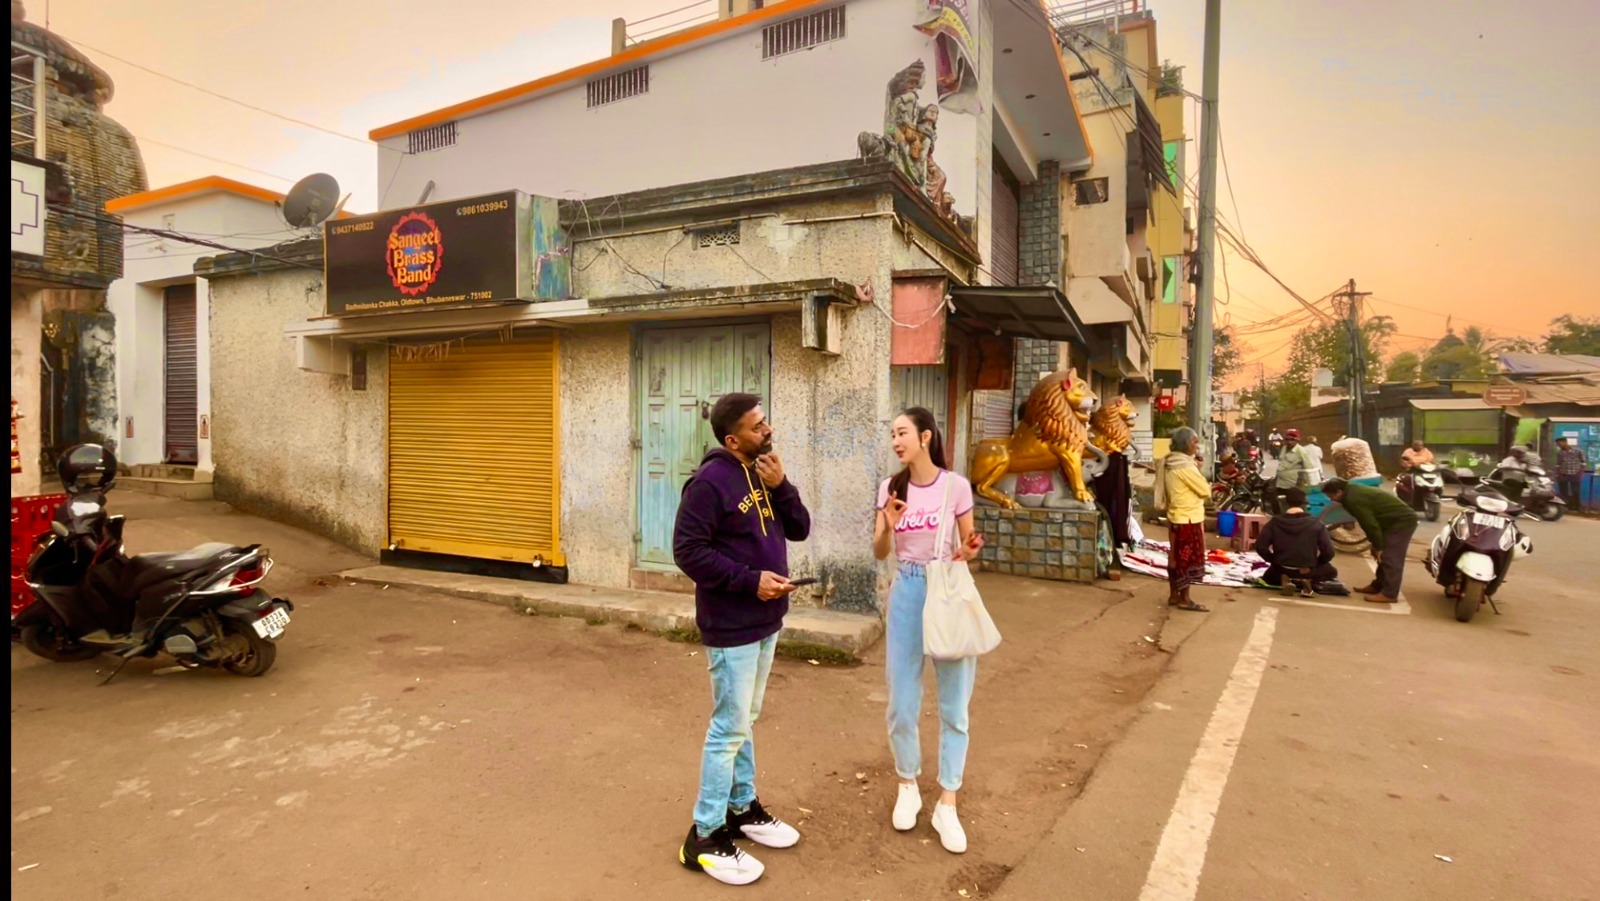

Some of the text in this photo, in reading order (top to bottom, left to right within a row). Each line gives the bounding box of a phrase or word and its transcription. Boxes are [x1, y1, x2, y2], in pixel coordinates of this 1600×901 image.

[461, 200, 509, 216] 9861039943
[388, 228, 440, 249] Sangeet
[394, 249, 435, 268] Brass
[397, 267, 432, 284] Band
[426, 294, 466, 304] Bhubaneswar
[470, 291, 492, 300] 751002
